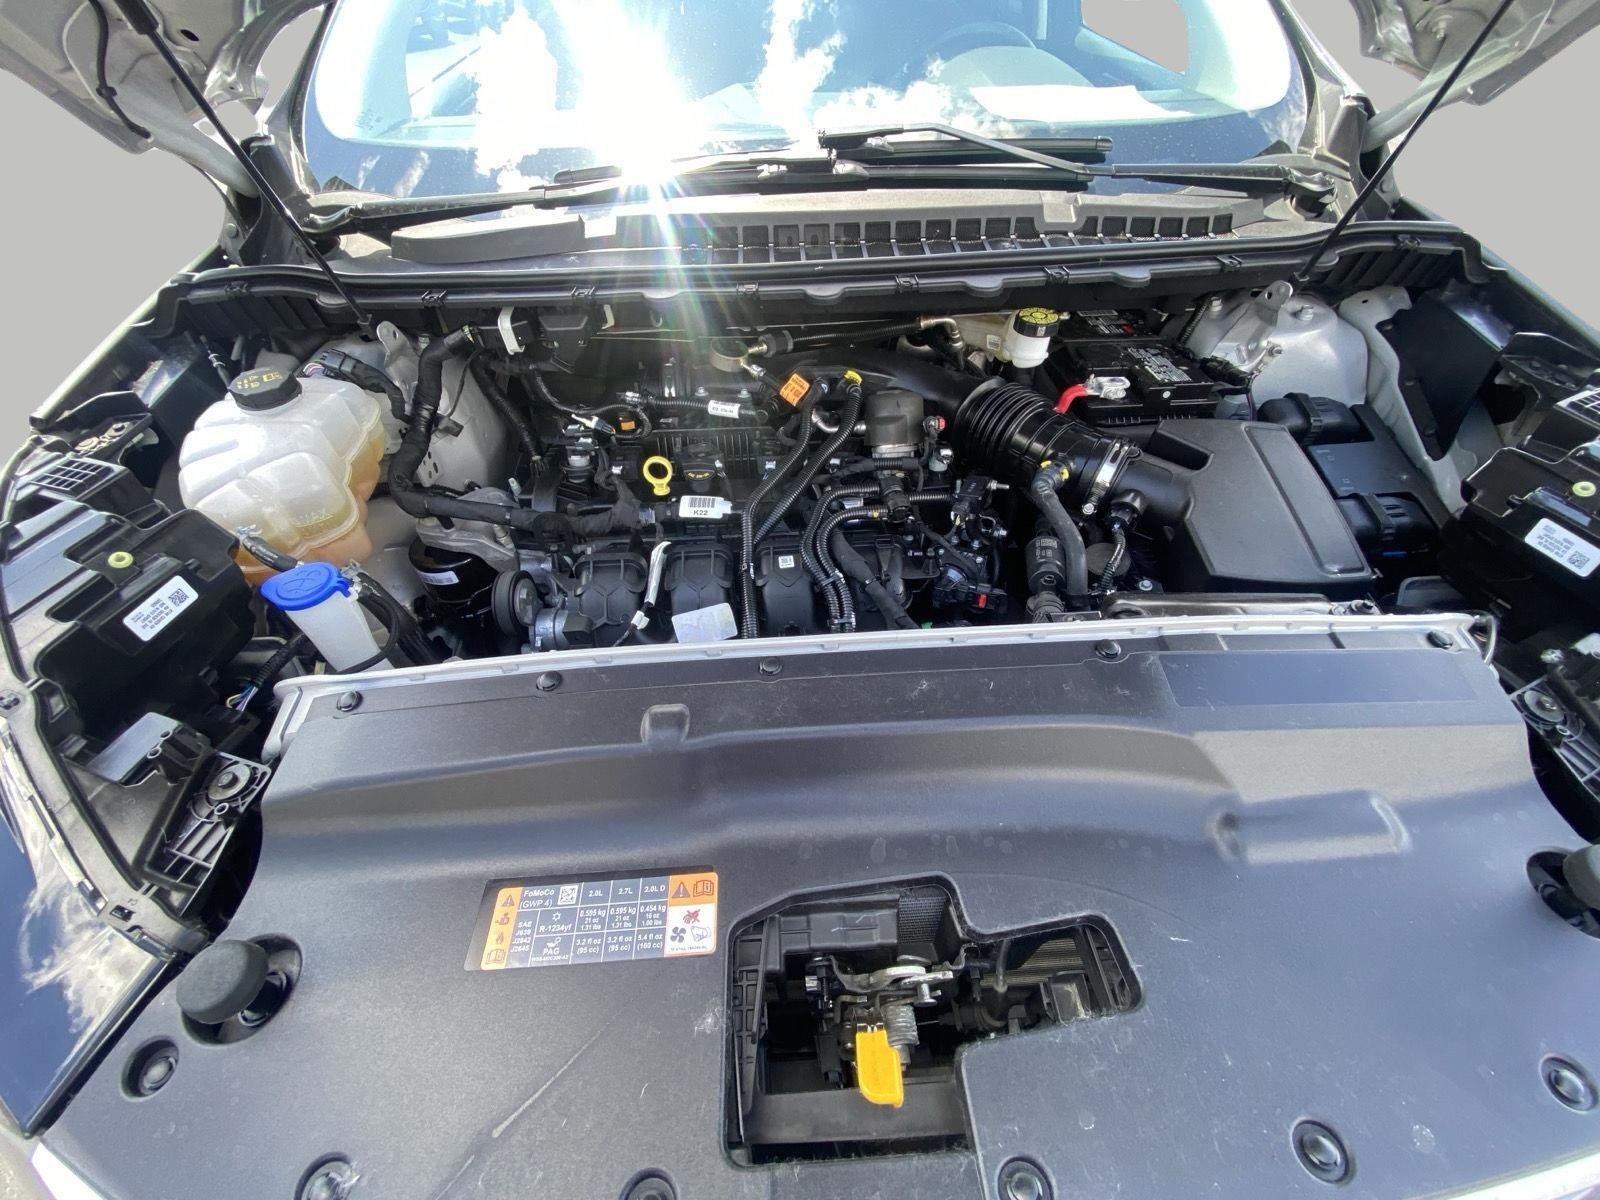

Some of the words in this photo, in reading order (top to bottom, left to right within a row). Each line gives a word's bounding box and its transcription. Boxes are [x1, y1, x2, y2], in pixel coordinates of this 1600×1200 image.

[523, 889, 554, 897] FoMoCo
[588, 889, 603, 897] 2.0L
[520, 900, 543, 909] (GWP
[544, 899, 552, 908] 4)
[597, 909, 606, 917] kg
[628, 906, 637, 914] kg
[539, 924, 572, 933] R-1234yf
[543, 948, 560, 956] PAG
